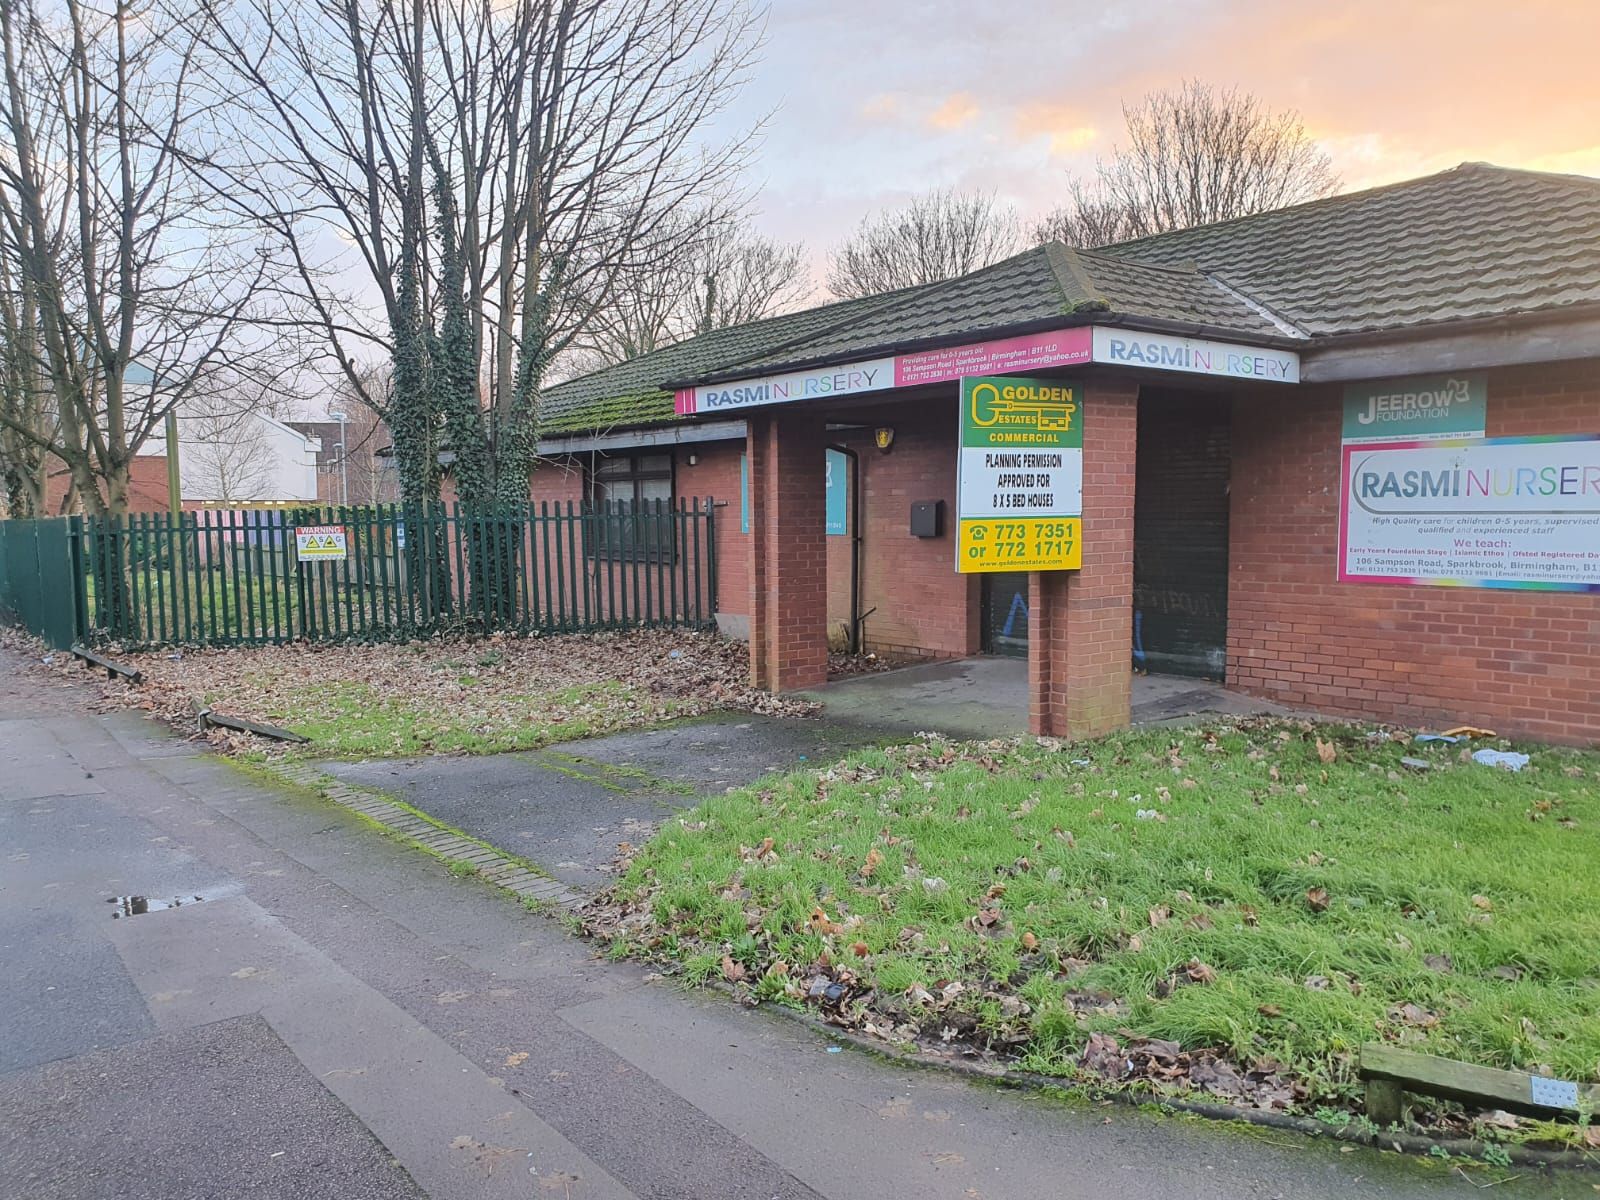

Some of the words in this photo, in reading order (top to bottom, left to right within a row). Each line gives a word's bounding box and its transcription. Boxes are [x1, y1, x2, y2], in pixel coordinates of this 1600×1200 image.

[912, 363, 937, 372] Sampson
[937, 360, 952, 368] Road
[955, 356, 986, 366] Sparkbrook
[991, 349, 1027, 360] Birmingham
[958, 349, 973, 358] years
[1110, 338, 1190, 368] RASMI
[1194, 349, 1290, 378] NURSERY
[706, 385, 770, 407] RASMI
[773, 369, 878, 399] NURSERY
[1002, 386, 1073, 401] GOLDEN
[1358, 389, 1454, 424] JEEROW
[999, 415, 1037, 424] ESTATES
[1377, 408, 1449, 422] FOUNDATION
[989, 433, 1059, 443] COMMERCIAL
[985, 453, 1021, 468] PLANNING
[1023, 453, 1062, 468] PERMISSION
[997, 474, 1034, 488] APPROVED
[1036, 474, 1050, 487] FOR
[1361, 469, 1460, 498] RASMI
[1466, 466, 1600, 497] NURSER
[993, 494, 998, 507] 8
[999, 494, 1005, 507] X
[1006, 494, 1011, 507] 5
[1012, 494, 1026, 507] BED
[1028, 493, 1054, 507] HOUSES
[1372, 517, 1391, 526] High
[1392, 517, 1421, 526] Quality
[1456, 517, 1492, 525] children
[1544, 517, 1599, 526] supervised
[302, 526, 341, 534] WARNING
[995, 524, 1026, 539] 773
[1034, 523, 1073, 538] 7351
[1417, 526, 1454, 534] qualified
[1473, 527, 1530, 535] experienced
[1532, 526, 1555, 534] staff
[968, 547, 986, 558] or
[995, 542, 1026, 557] 772
[1034, 541, 1073, 556] 1717
[1453, 538, 1472, 548] We
[1475, 539, 1512, 548] teach:
[1349, 547, 1366, 555] Early
[1426, 549, 1447, 557] Stage
[1540, 551, 1585, 559] Registered
[1356, 557, 1372, 565] 106
[1374, 558, 1415, 567] Sampson
[1583, 563, 1600, 571] B1
